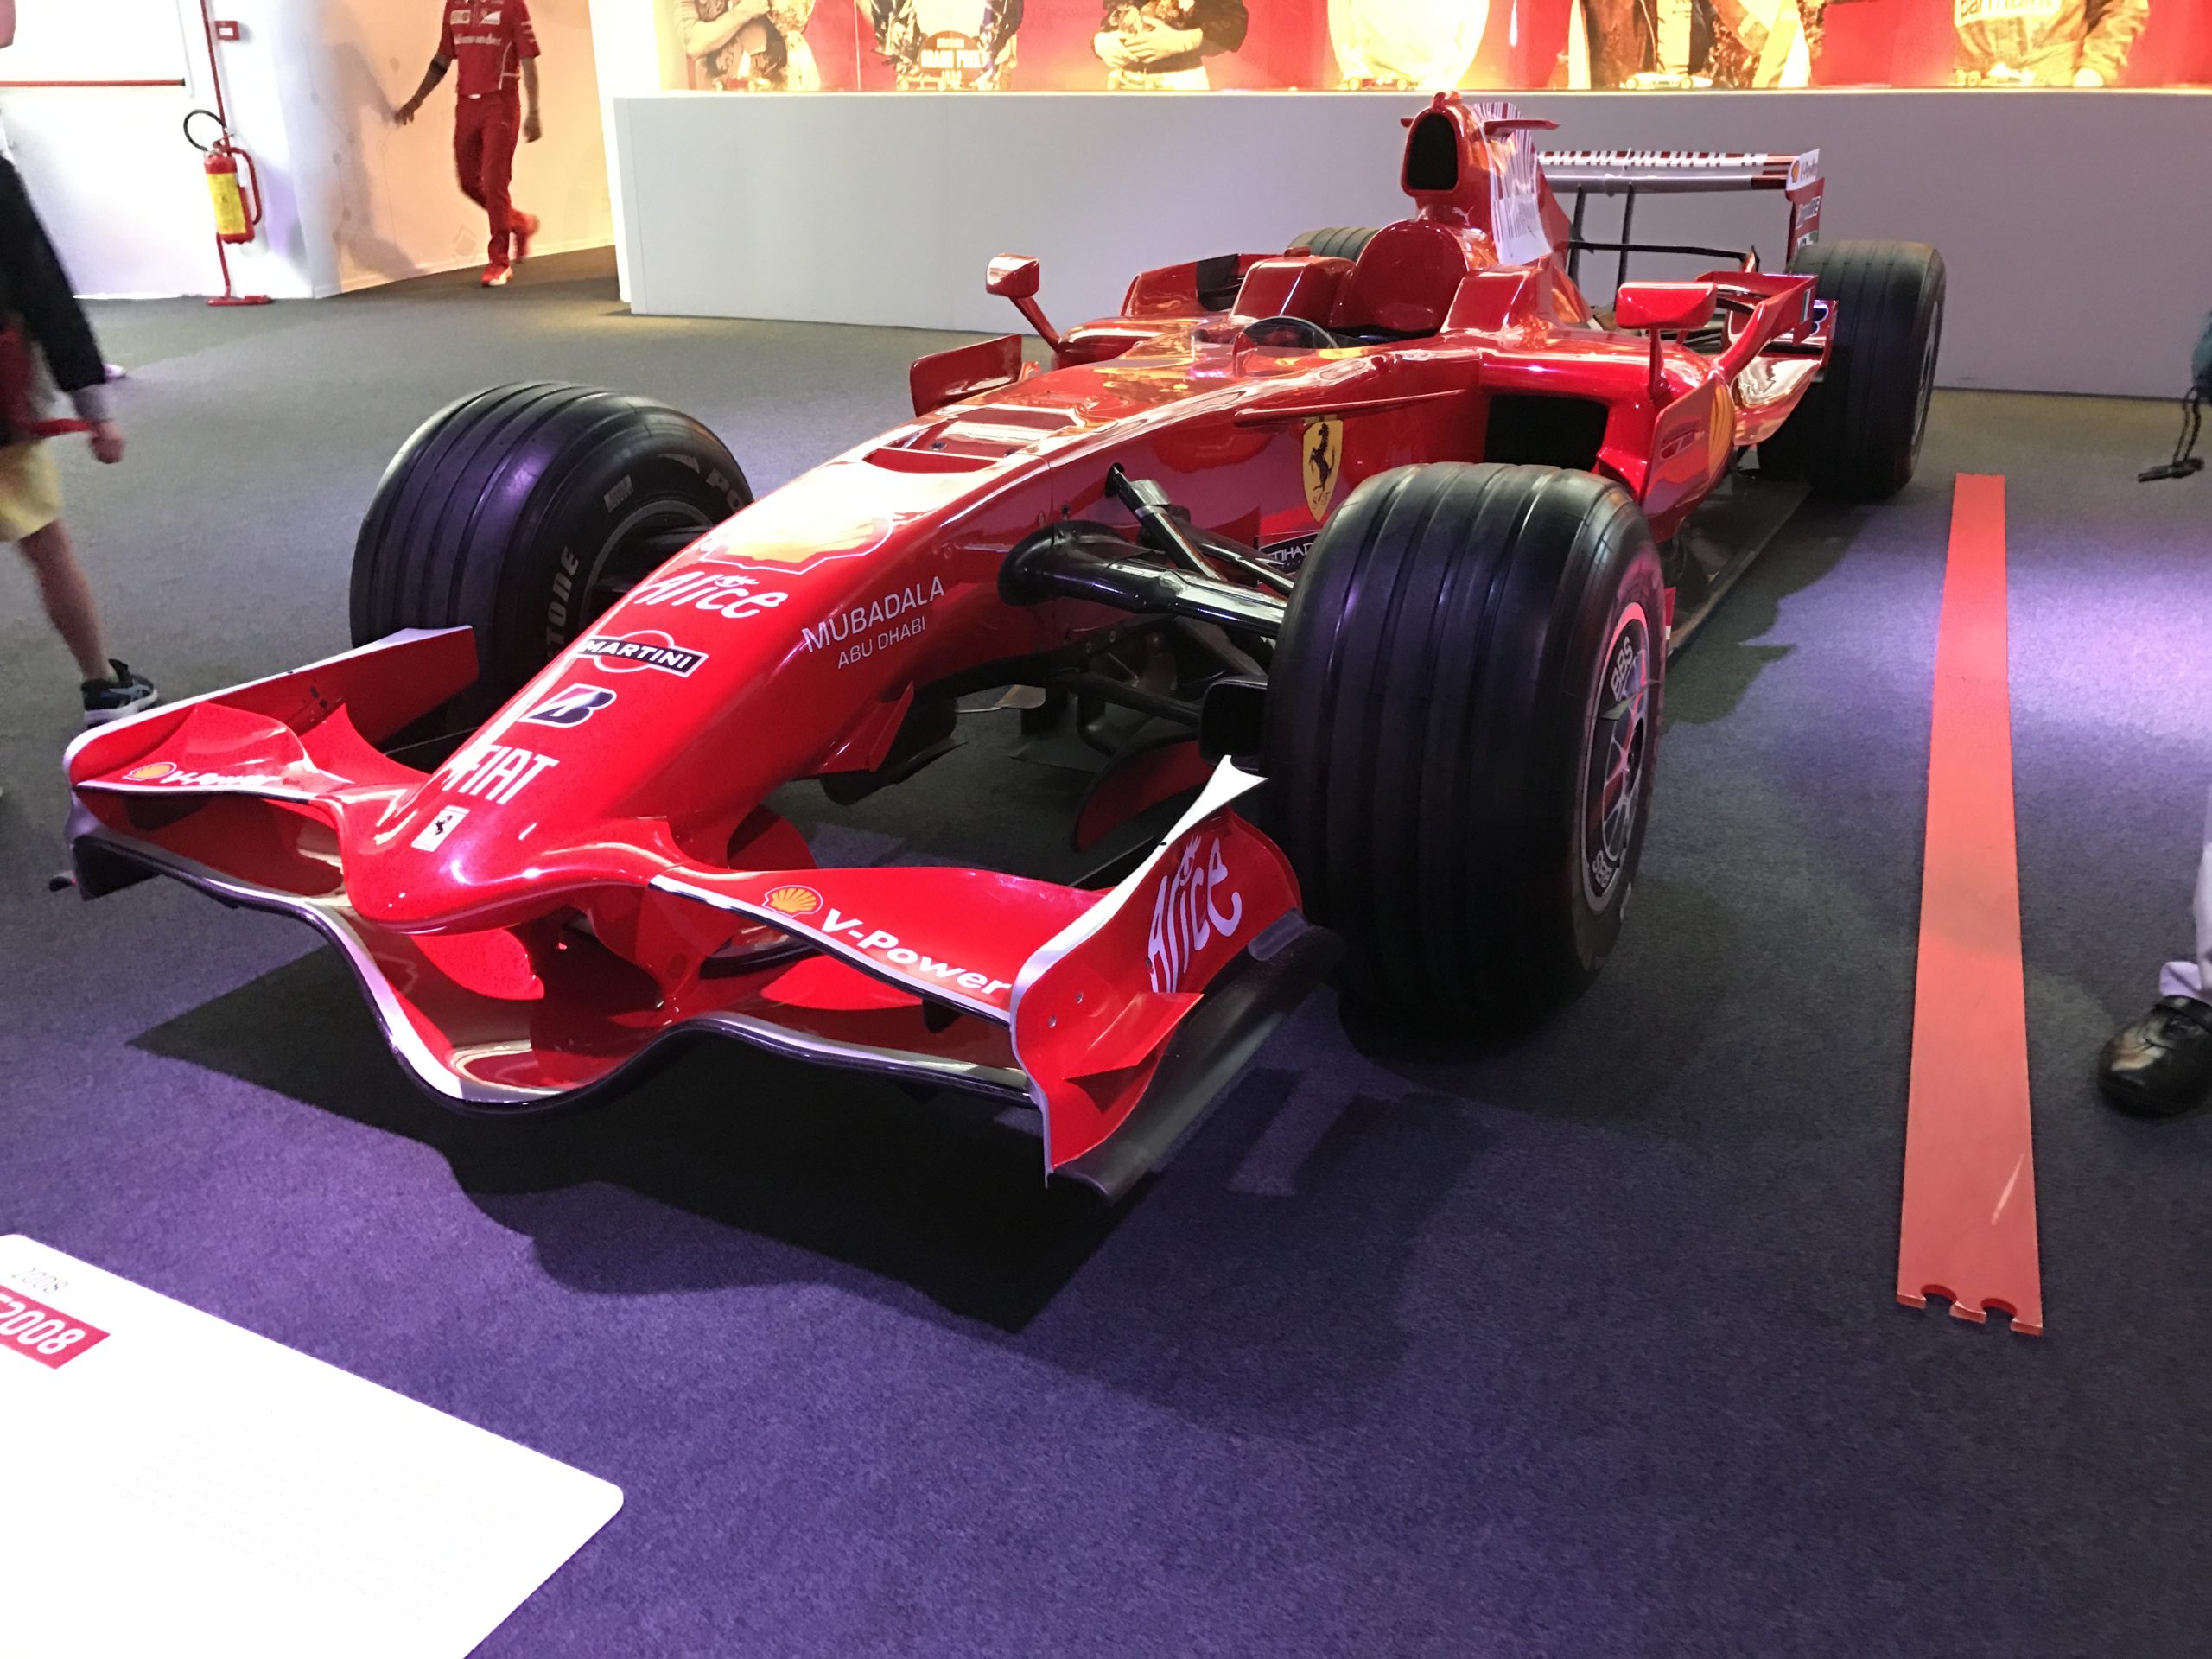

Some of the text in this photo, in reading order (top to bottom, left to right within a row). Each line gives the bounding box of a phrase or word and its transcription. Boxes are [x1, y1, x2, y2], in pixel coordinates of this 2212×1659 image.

[920, 49, 954, 68] GRAND
[633, 570, 789, 619] Alice
[801, 575, 945, 653] MUBADALA
[578, 639, 694, 670] MARTINI
[837, 615, 926, 670] ABU DHABI
[1610, 635, 1634, 702] BBS
[442, 744, 560, 805] FIAT
[1147, 835, 1243, 994] Alice
[821, 908, 1013, 995] V-Power
[11, 1267, 68, 1294] 2008
